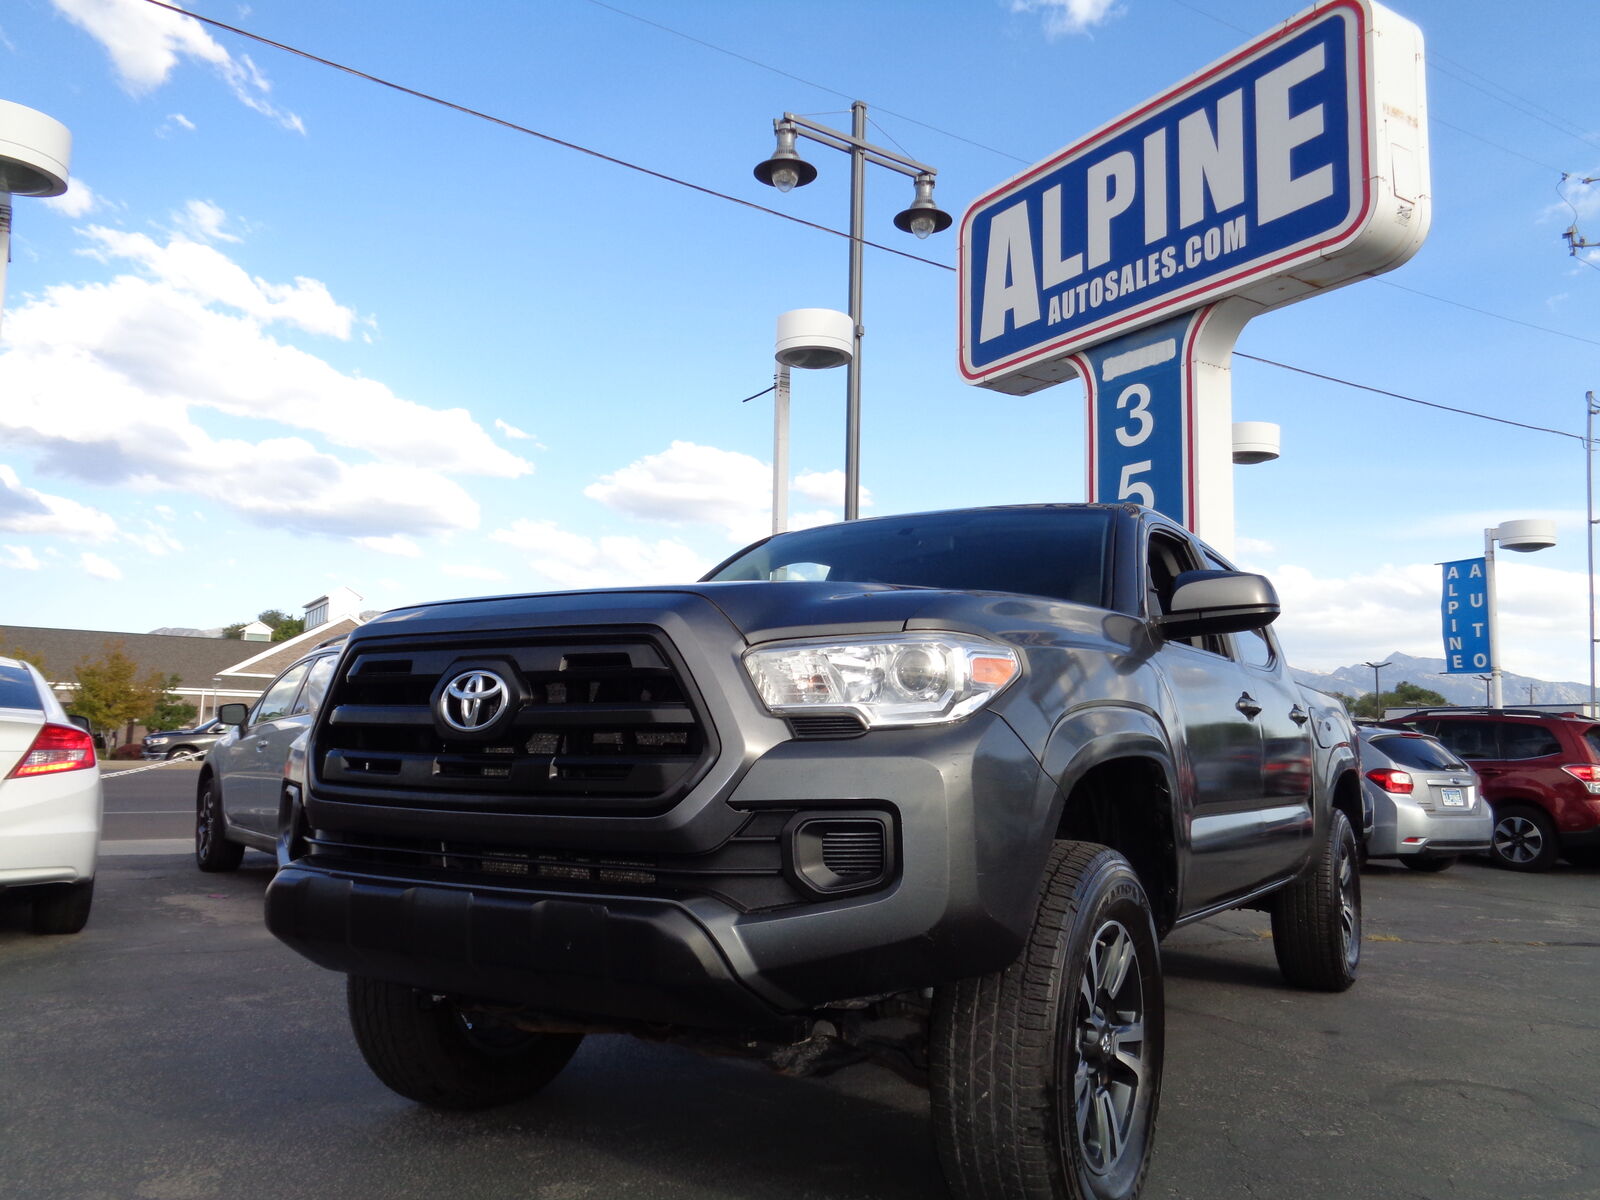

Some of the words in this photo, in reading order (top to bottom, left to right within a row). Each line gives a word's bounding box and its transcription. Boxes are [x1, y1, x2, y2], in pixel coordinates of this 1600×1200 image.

[979, 42, 1335, 345] ALPINE
[1047, 214, 1248, 326] AUTOSALES.COM
[1447, 566, 1463, 669] ALPINE
[1469, 564, 1487, 668] AUTO
